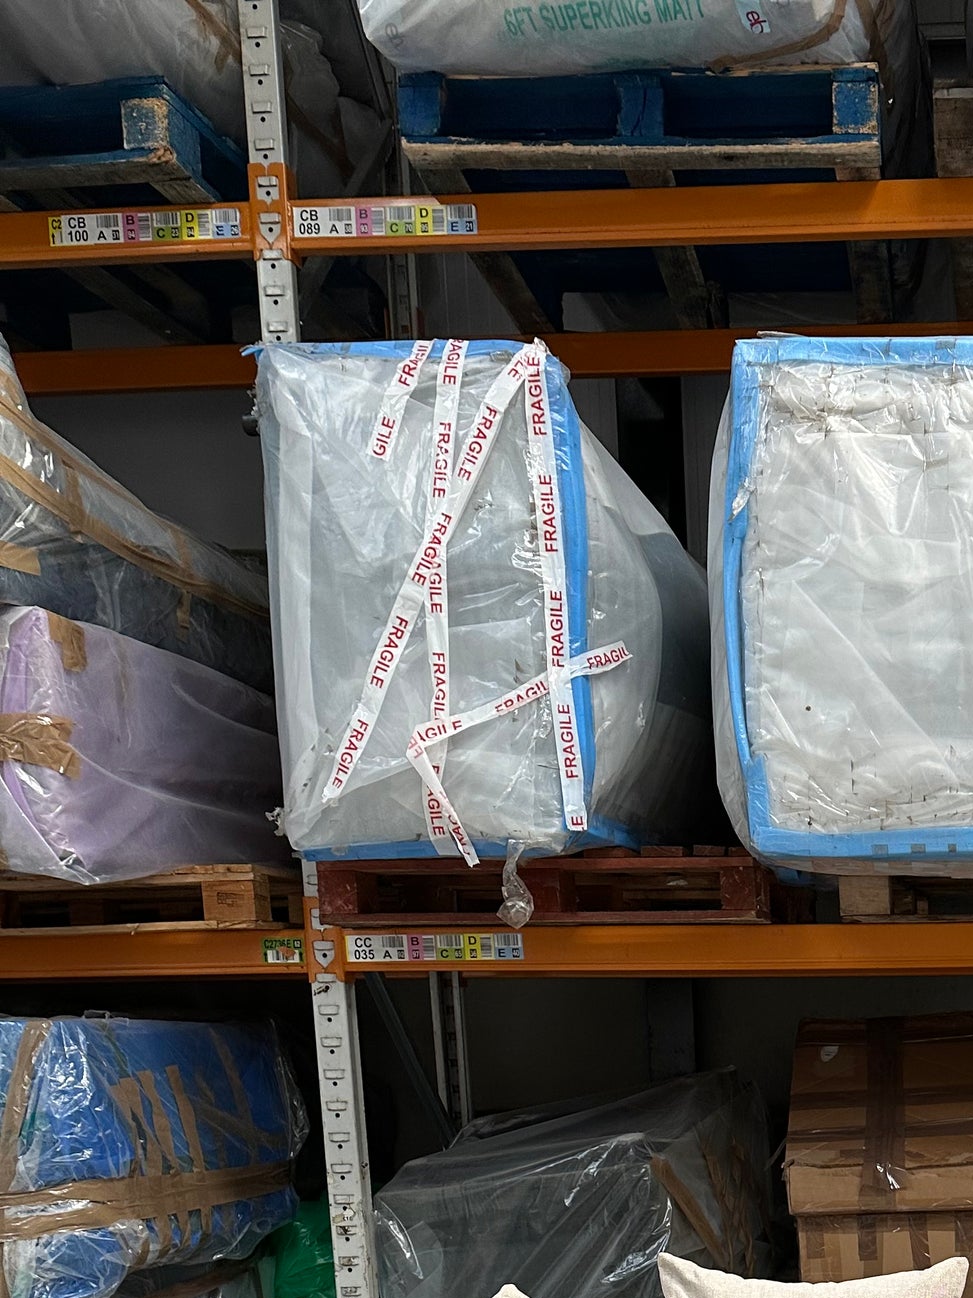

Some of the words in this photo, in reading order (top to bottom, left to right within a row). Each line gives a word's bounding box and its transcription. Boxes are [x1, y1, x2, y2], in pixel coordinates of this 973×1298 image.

[503, 6, 538, 37] 6FT
[538, 0, 651, 33] SUPERKING
[185, 212, 195, 223] D
[300, 209, 319, 222] CB
[359, 209, 368, 219] B
[419, 208, 429, 218] D
[68, 216, 86, 229] CB
[126, 215, 135, 225] B
[215, 225, 225, 236] E
[299, 223, 321, 235] 089
[329, 224, 339, 234] A
[390, 222, 399, 233] C
[451, 221, 459, 232] E
[67, 230, 89, 242] 100
[97, 230, 107, 241] A
[156, 228, 166, 239] C
[526, 356, 548, 436] FRAGILE
[458, 405, 498, 482] FRAGILE
[538, 474, 559, 553] FRAGILE
[411, 512, 453, 587] FRAGILE
[550, 590, 565, 668] FRAGILE
[370, 615, 409, 689] FRAGILE
[557, 703, 579, 780] FRAGILE
[332, 718, 369, 789] FRAGILE
[354, 937, 373, 948] CC
[411, 936, 419, 946] B
[468, 935, 477, 945] D
[354, 949, 375, 960] 035
[383, 950, 392, 959] A
[440, 949, 449, 959] C
[498, 949, 506, 958] E
